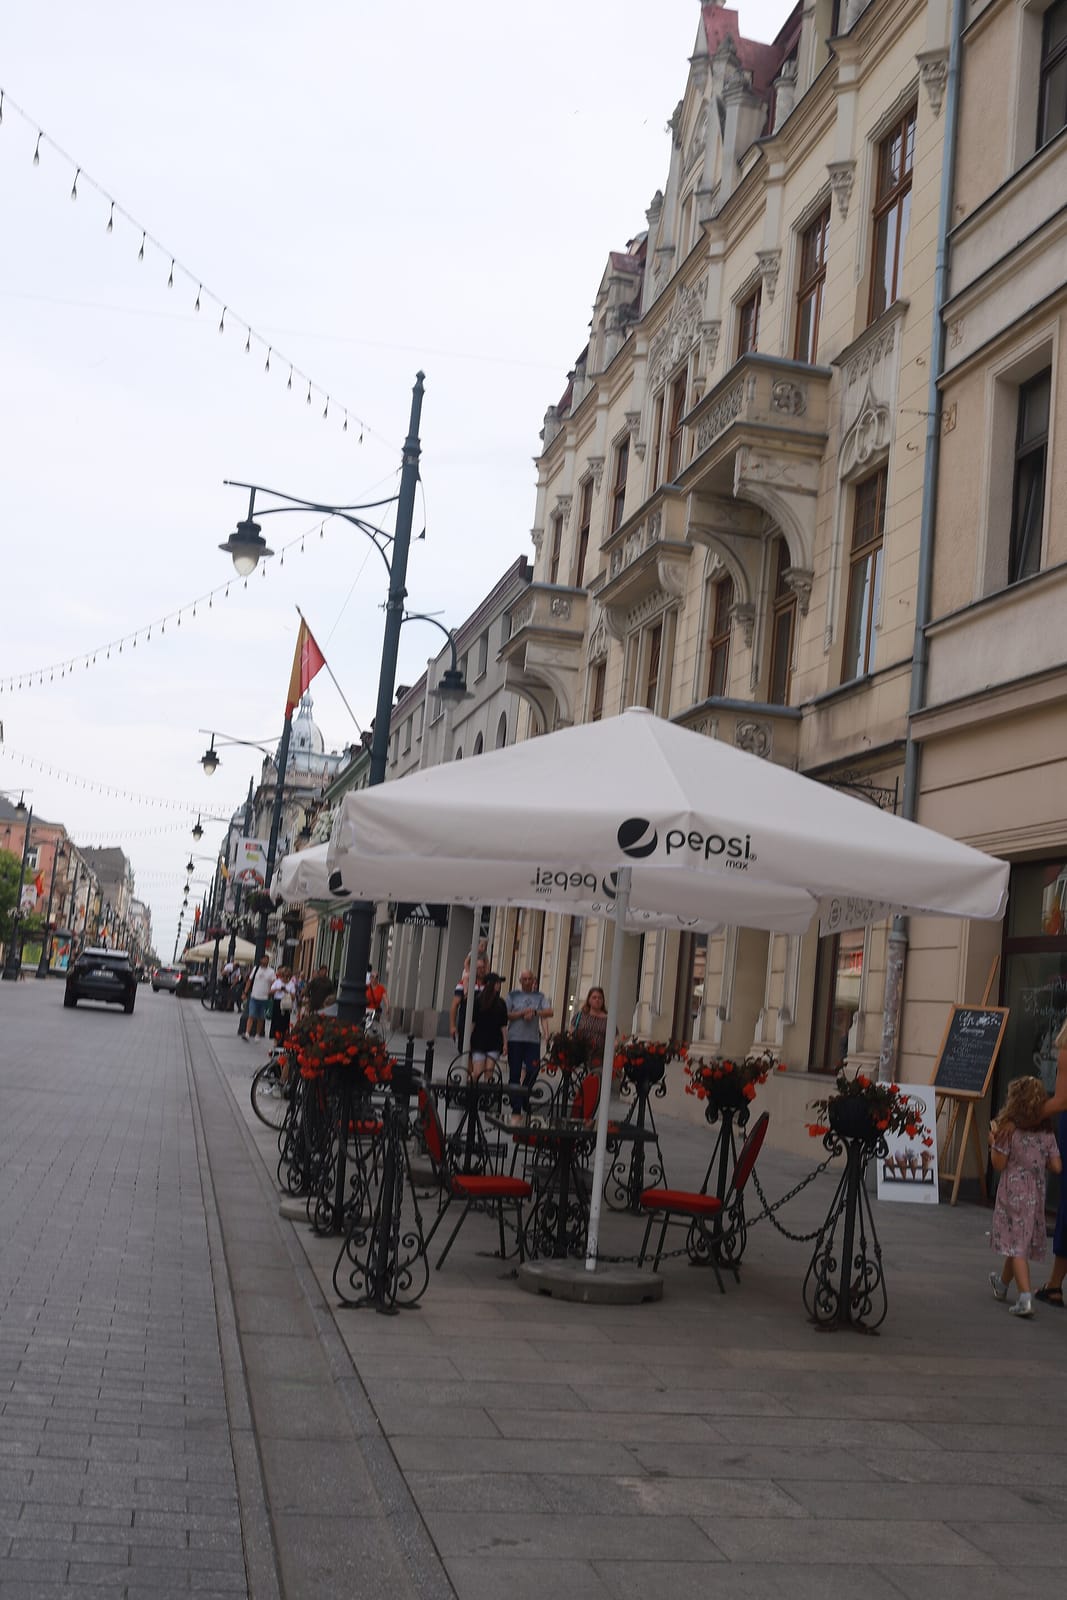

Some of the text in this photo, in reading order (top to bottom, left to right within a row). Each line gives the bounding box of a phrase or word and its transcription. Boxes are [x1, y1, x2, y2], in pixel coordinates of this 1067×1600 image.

[665, 829, 751, 860] pepsi
[725, 859, 749, 871] max
[404, 916, 436, 927] adidas
